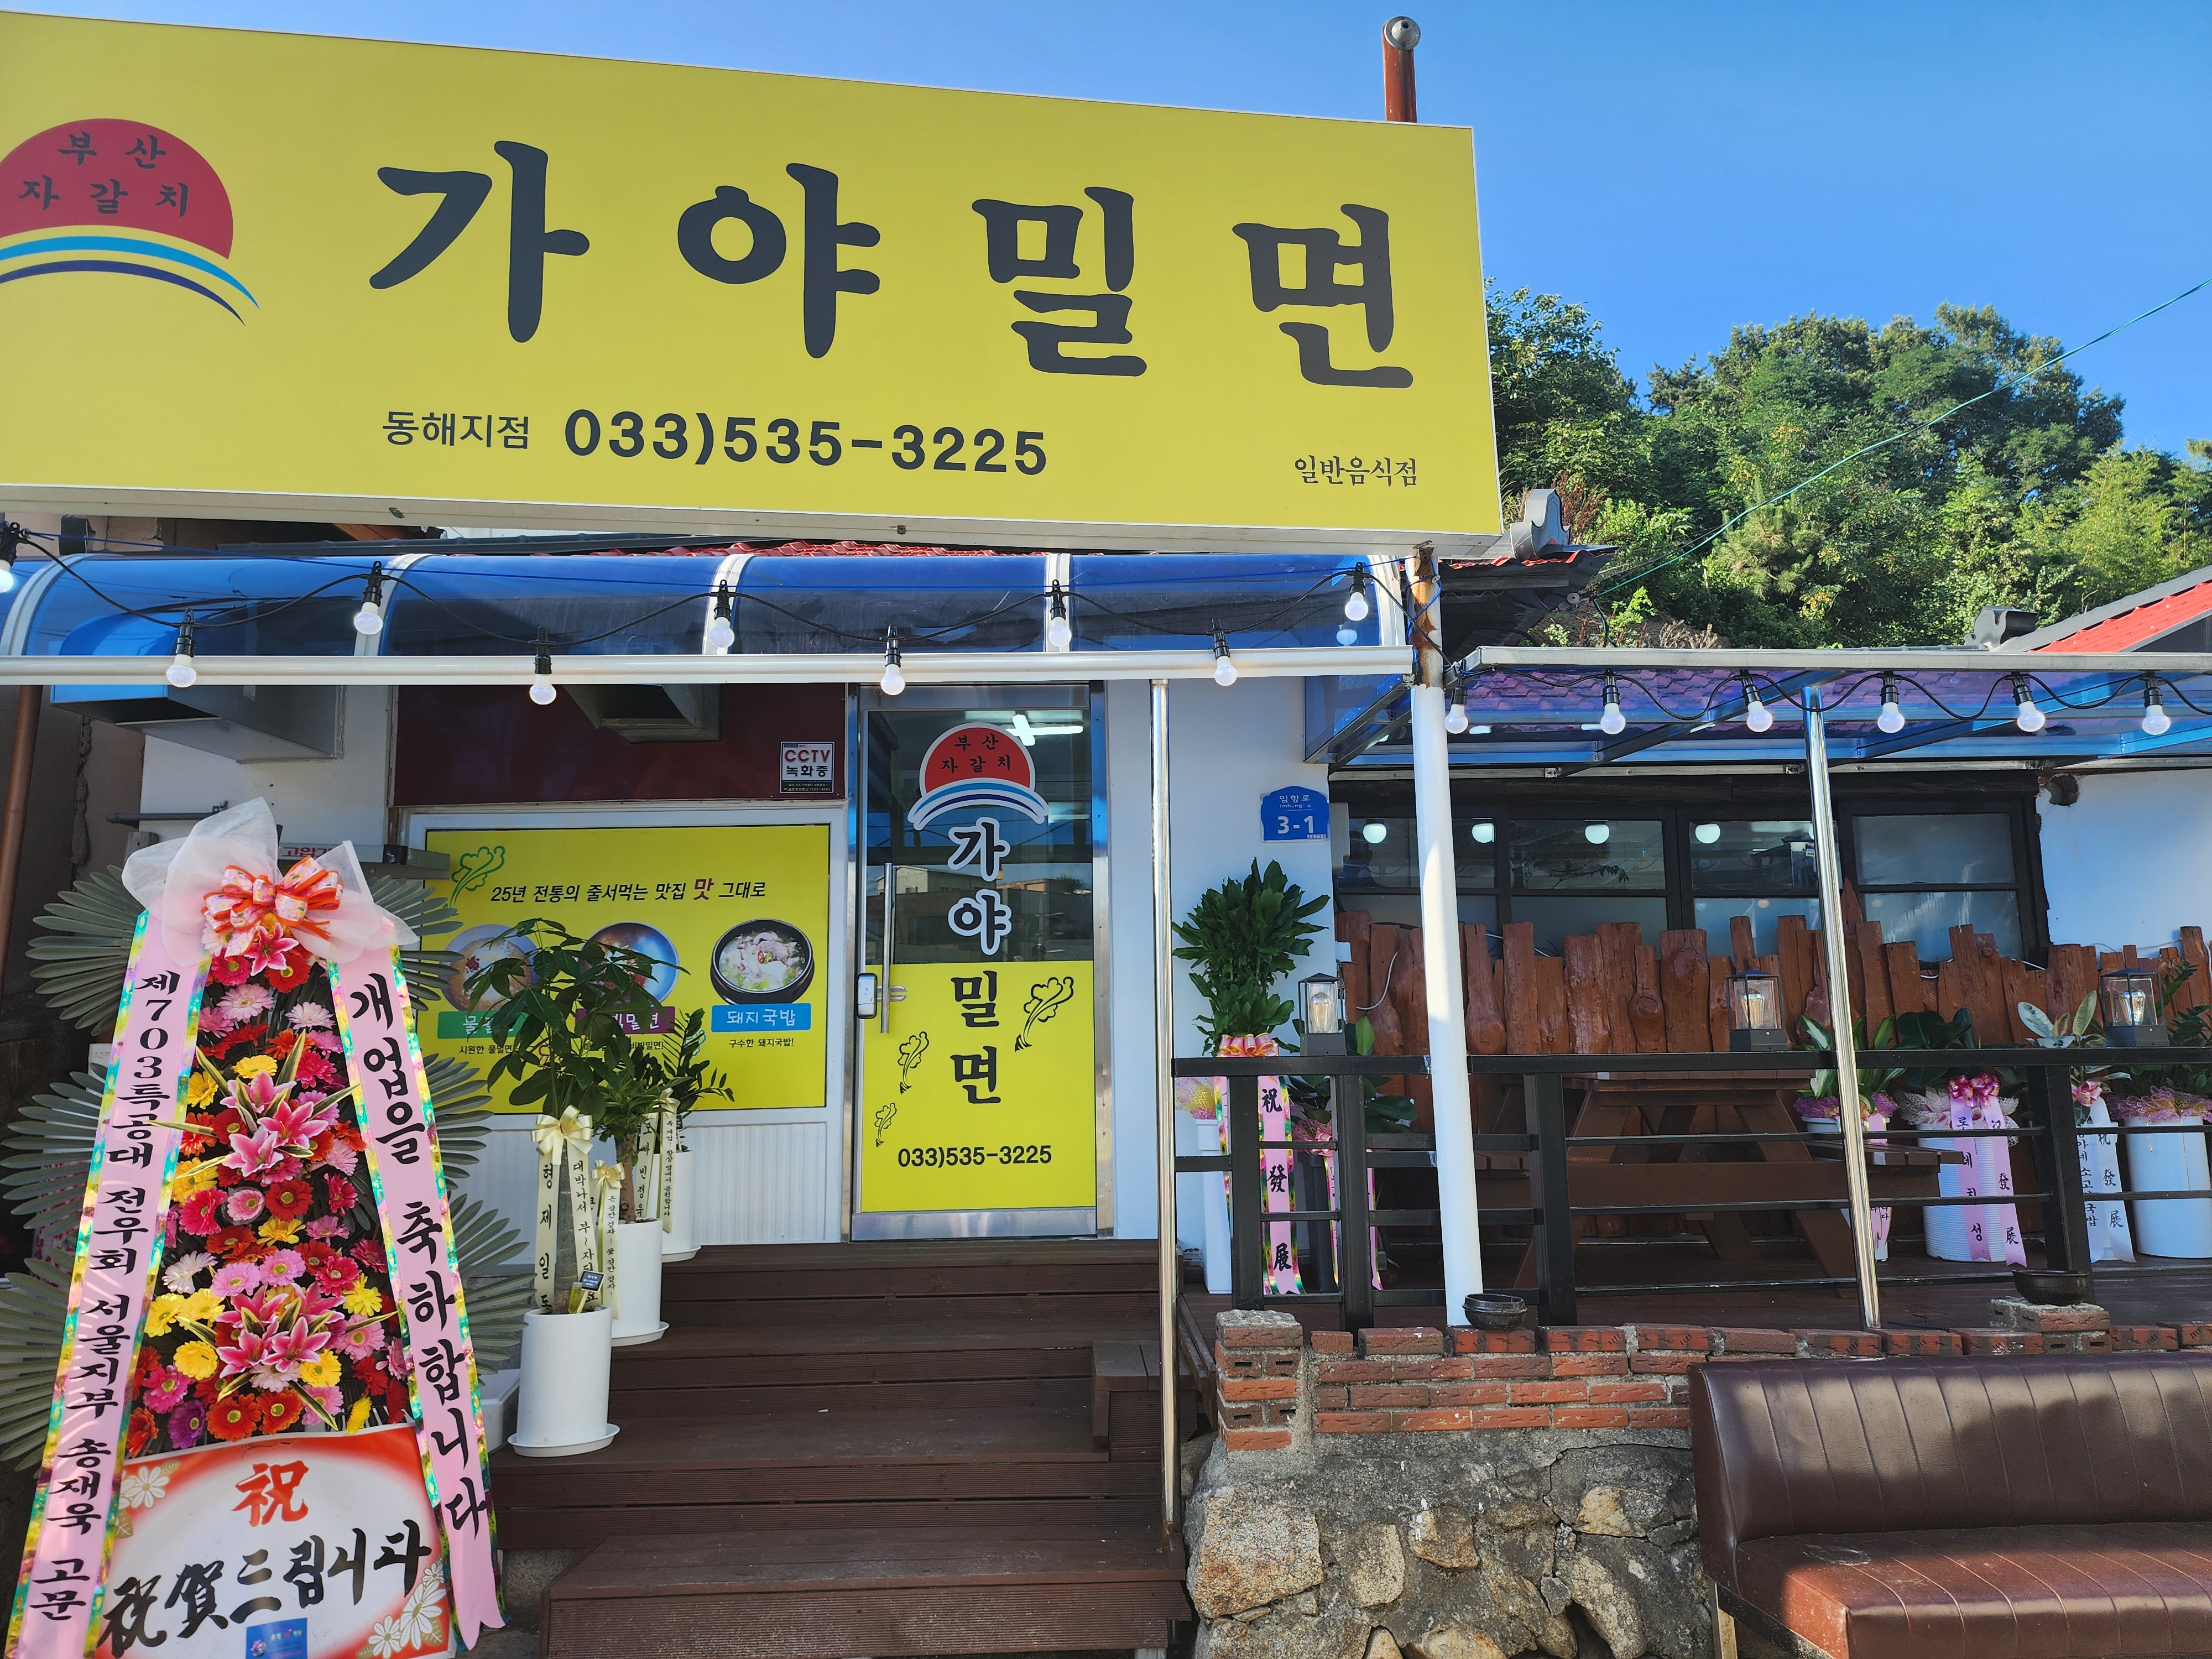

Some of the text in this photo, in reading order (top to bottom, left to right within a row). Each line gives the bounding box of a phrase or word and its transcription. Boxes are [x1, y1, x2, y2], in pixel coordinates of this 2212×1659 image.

[58, 132, 166, 169] 부산
[19, 174, 189, 217] 자갈치
[369, 139, 1414, 389] 가야밀면
[381, 409, 1048, 476] 동해지점 033)535-3225
[1295, 455, 1417, 487] 일반음식점
[785, 749, 831, 763] CCTV
[954, 733, 999, 752] 부산
[786, 765, 828, 777] 녹화중
[941, 754, 1011, 774] 자갈치
[1279, 795, 1311, 804] 임항로
[1277, 816, 1313, 834] 3-1
[491, 878, 766, 903] 25년 전통의 줄서먹는 맛집 맛 그대로
[948, 819, 1008, 1104] 가야밀면
[727, 1009, 795, 1026] 돼지국밥
[459, 1045, 485, 1055] 시원한
[729, 1038, 794, 1048] 구수한 돼지국밥!
[898, 1145, 1052, 1168] 033)535-3225
[573, 1160, 588, 1213] 대박나서
[2081, 1167, 2098, 1226] 소고국밥
[349, 973, 488, 1540] 개업을 축하합니다
[29, 969, 180, 1621] 제703특공대 전우회 서울지부 송재욱 고문
[230, 1460, 309, 1527] 祝
